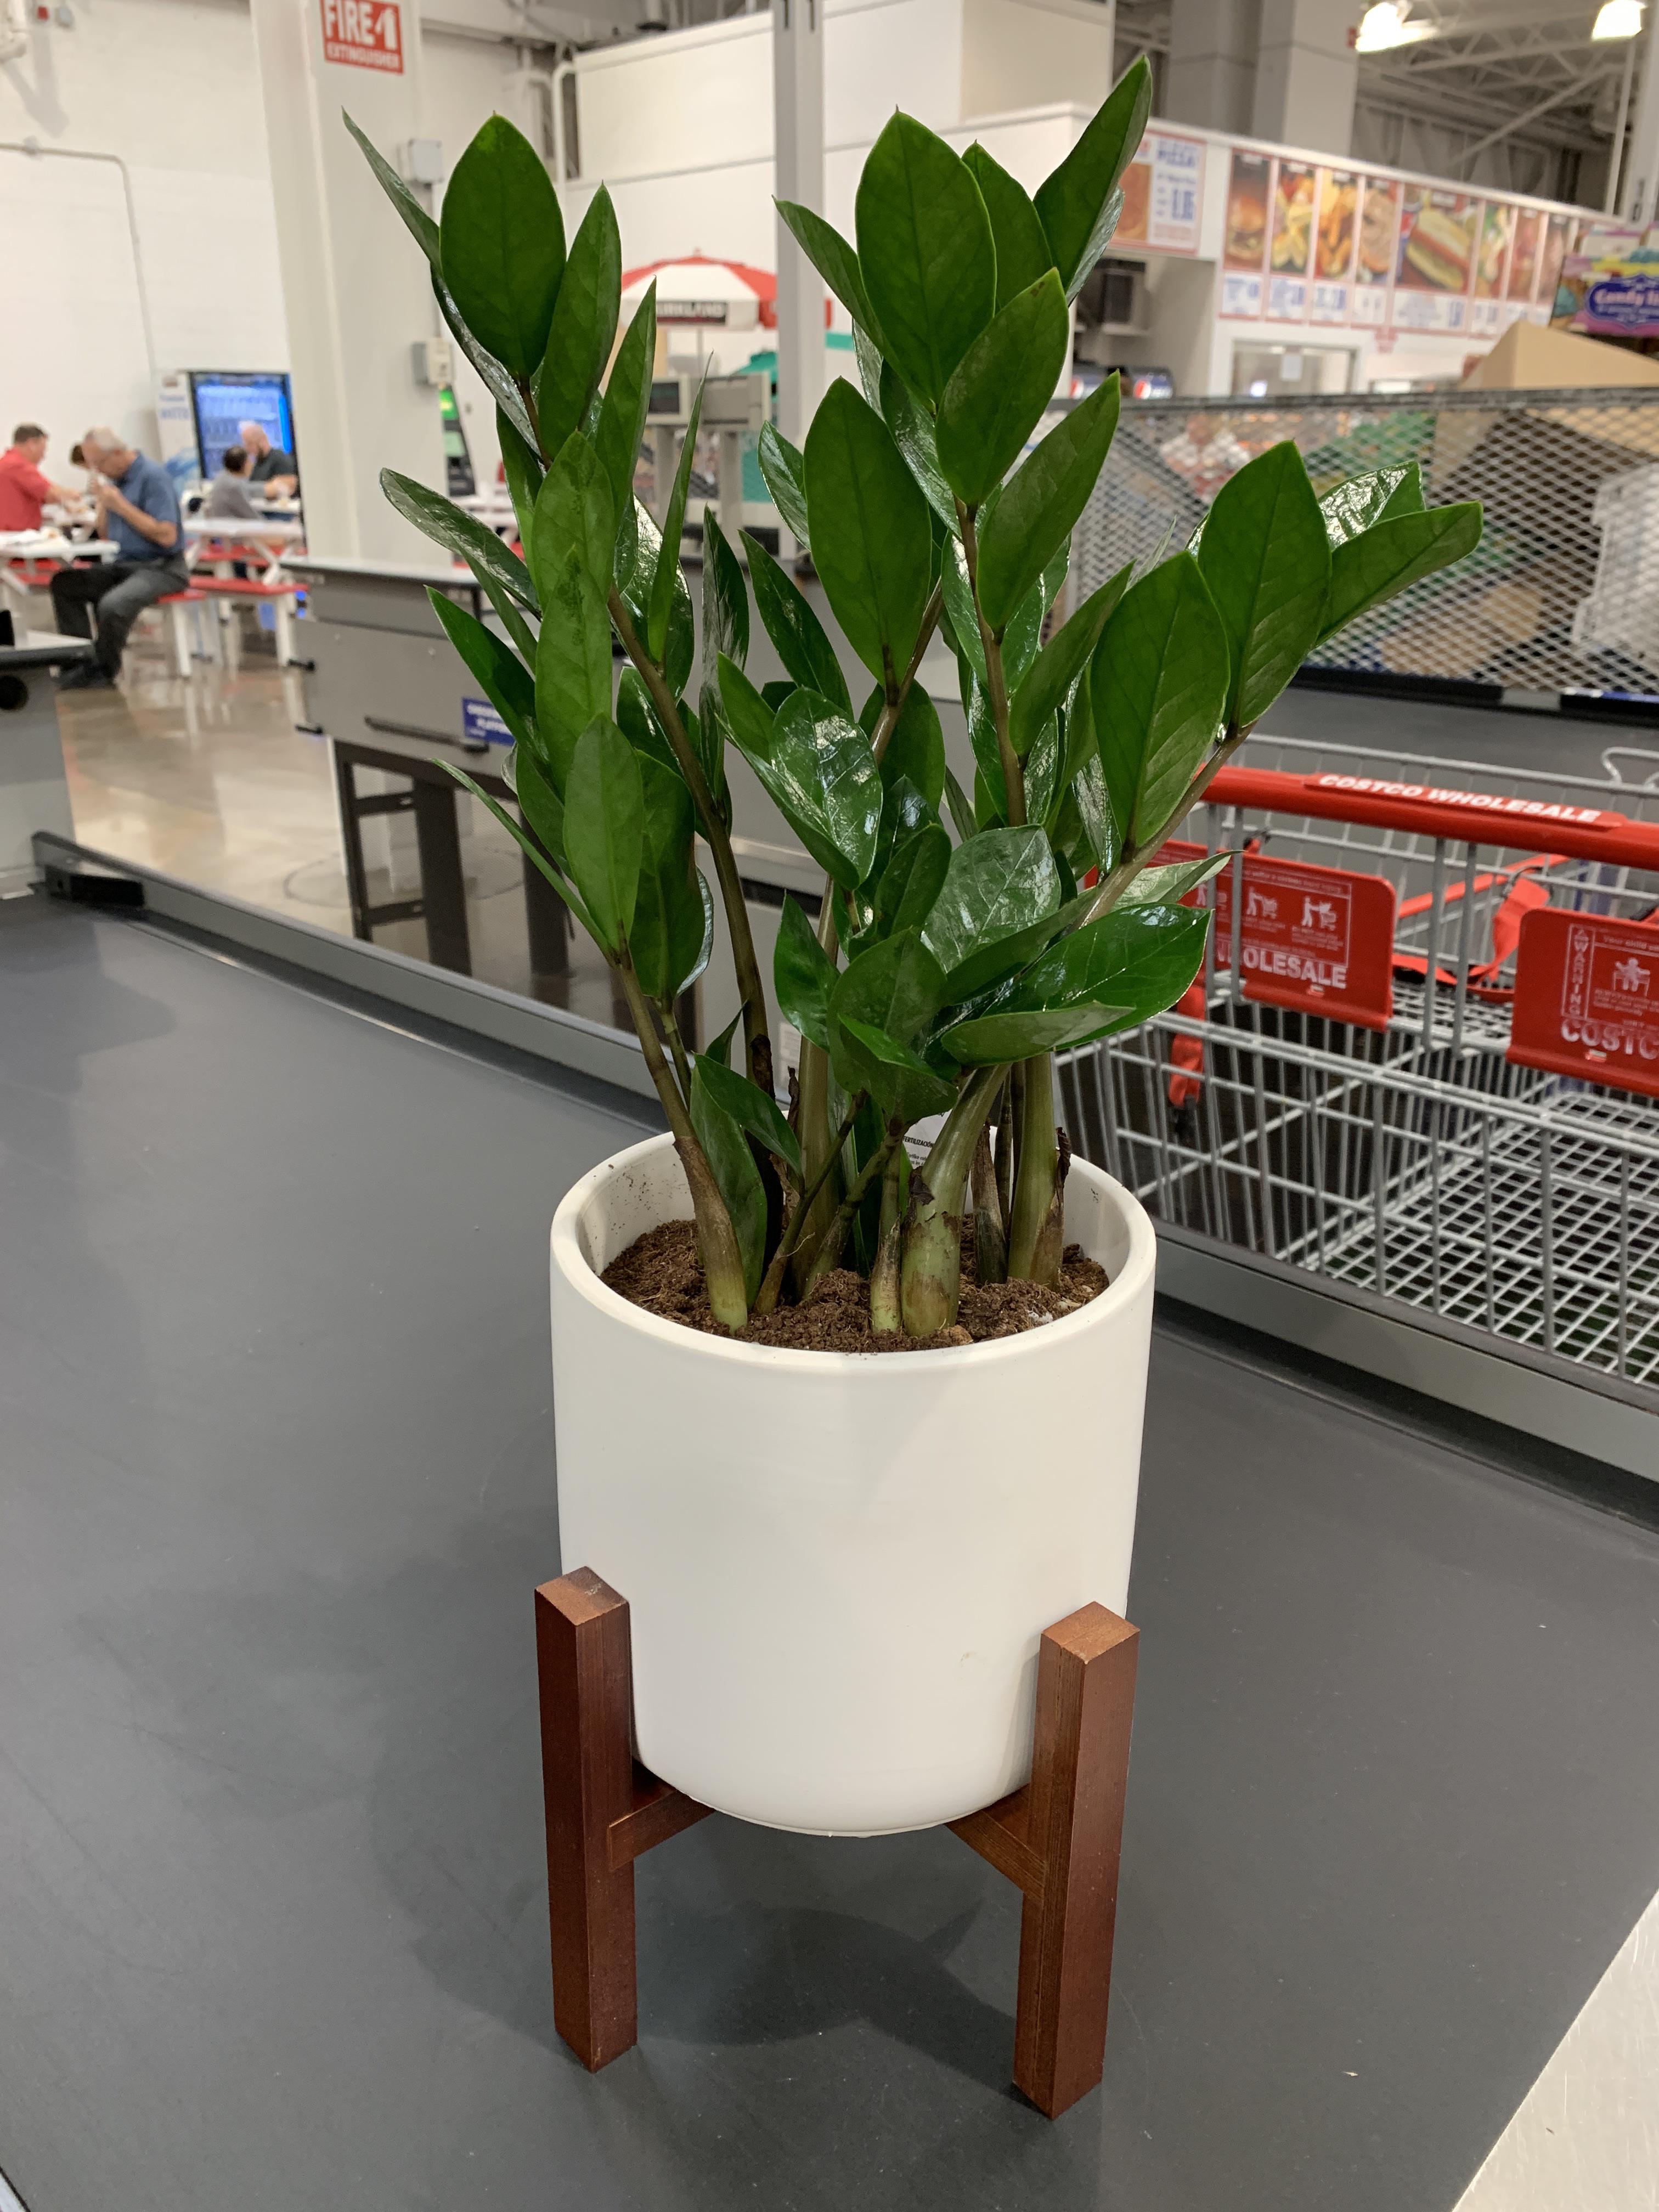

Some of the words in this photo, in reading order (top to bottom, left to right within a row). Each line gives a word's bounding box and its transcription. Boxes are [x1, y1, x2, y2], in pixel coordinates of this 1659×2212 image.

[325, 0, 375, 46] FIRE
[1319, 774, 1423, 797] COSTCO
[1427, 788, 1601, 823] WHOLESALE
